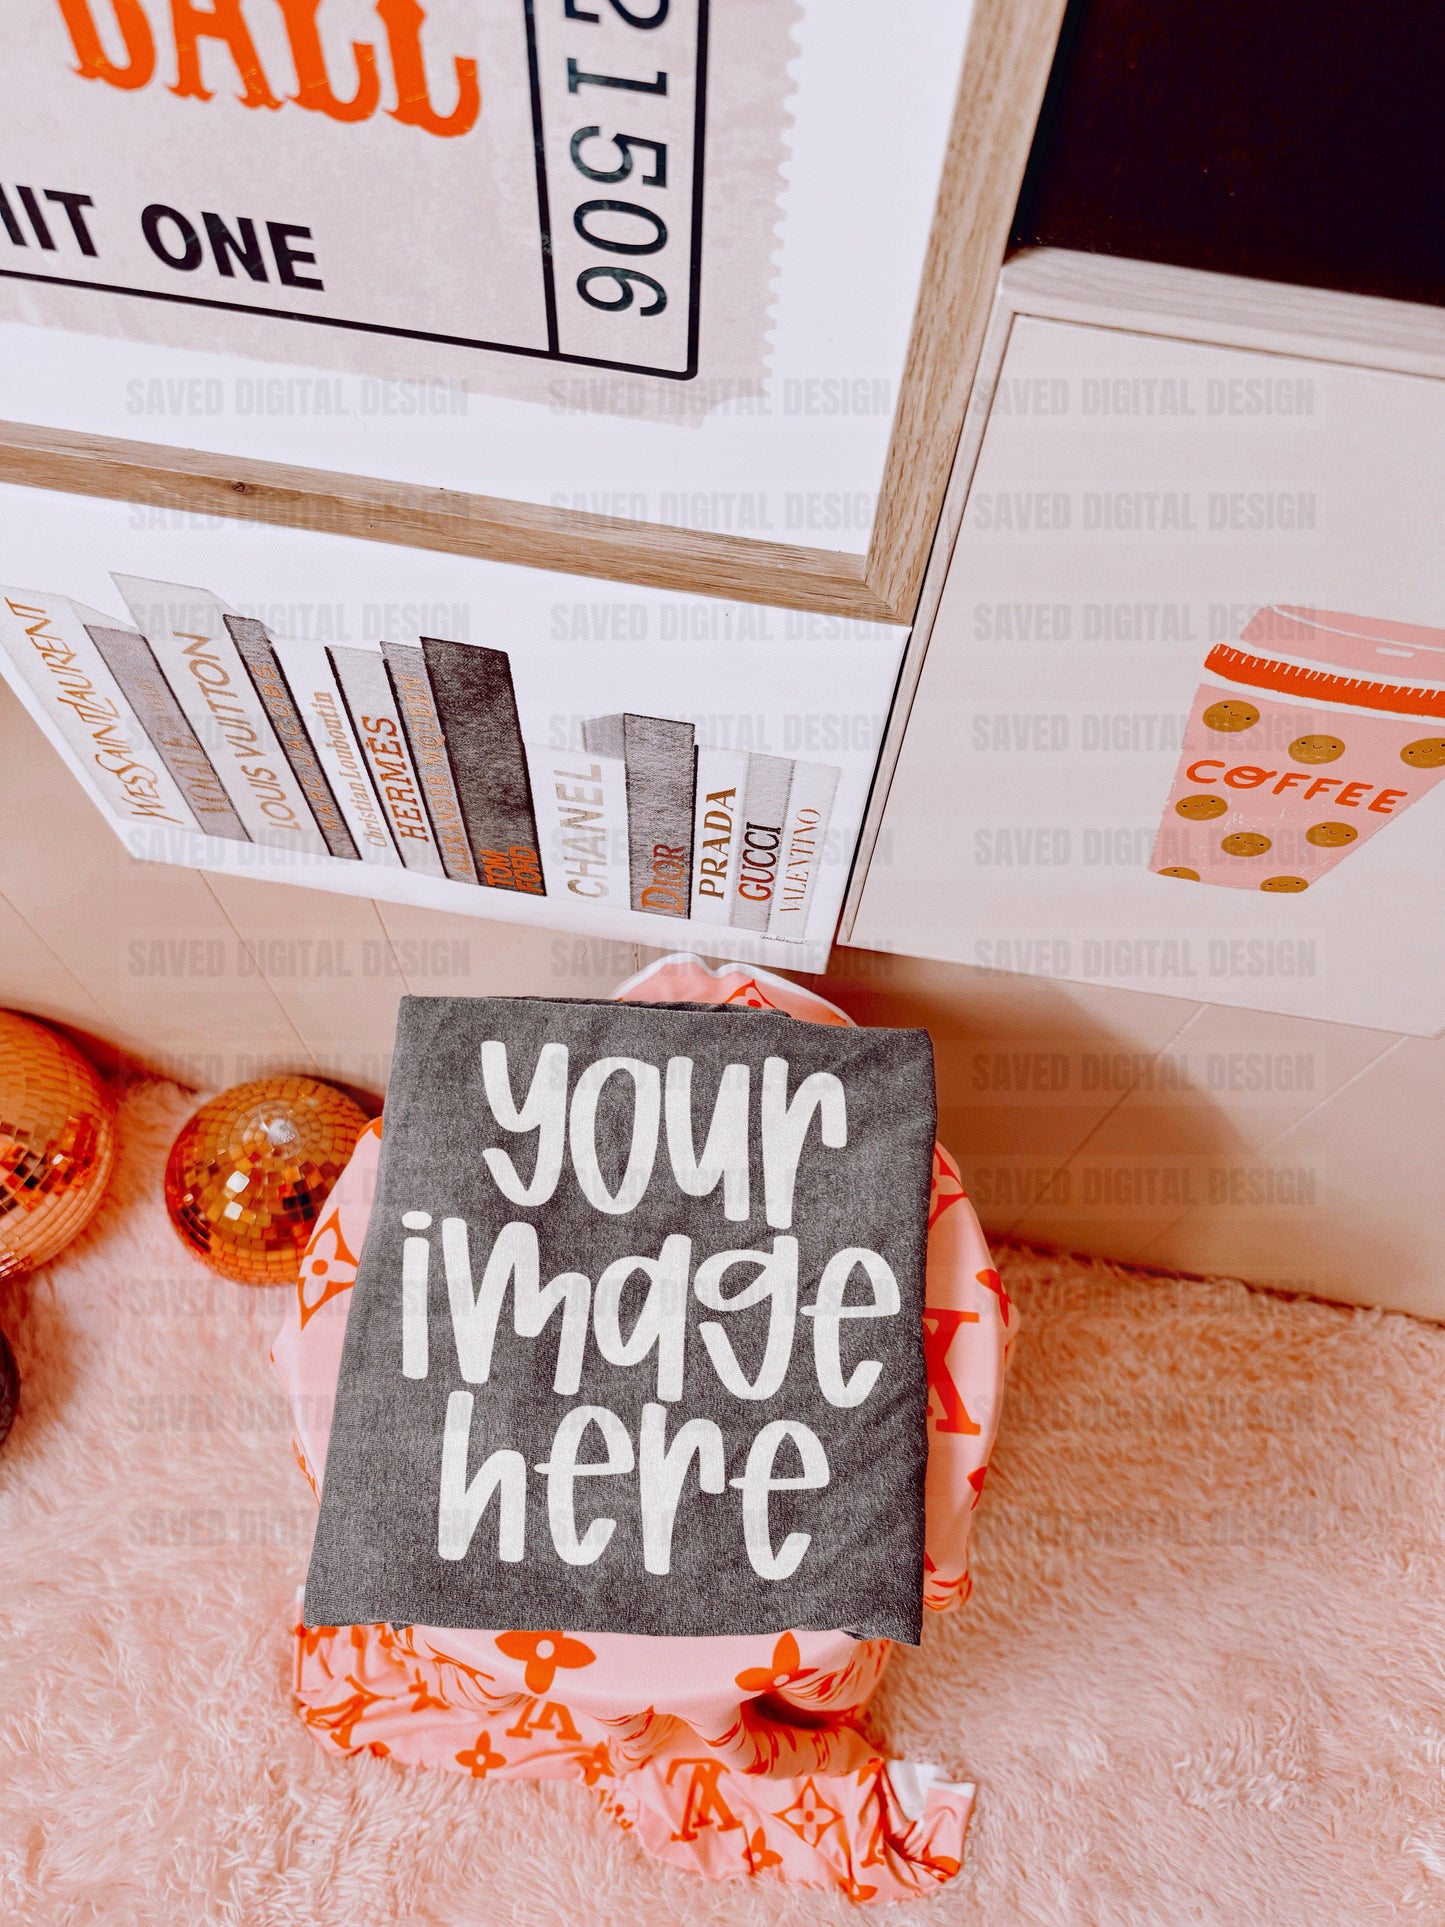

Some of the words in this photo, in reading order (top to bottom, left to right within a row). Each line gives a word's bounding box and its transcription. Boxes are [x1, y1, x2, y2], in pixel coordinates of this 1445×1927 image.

[141, 203, 325, 292] ONE
[172, 630, 267, 759] VUITTON
[253, 664, 313, 767] JACOBS
[312, 691, 362, 780] Louboutin
[241, 764, 302, 831] LOUIS
[302, 774, 338, 831] MARC
[348, 782, 388, 848] Christian
[425, 773, 474, 877] ALEXANDER
[553, 763, 609, 899] CHANEL
[1186, 759, 1408, 814] COFFEE
[480, 849, 514, 887] TOM
[509, 845, 545, 893] FORD
[699, 787, 737, 900] PRADA
[738, 821, 782, 901] GUCCI
[779, 808, 822, 912] VALENTINO
[481, 1040, 847, 1229] your
[401, 1211, 901, 1408] image
[438, 1390, 830, 1581] here
